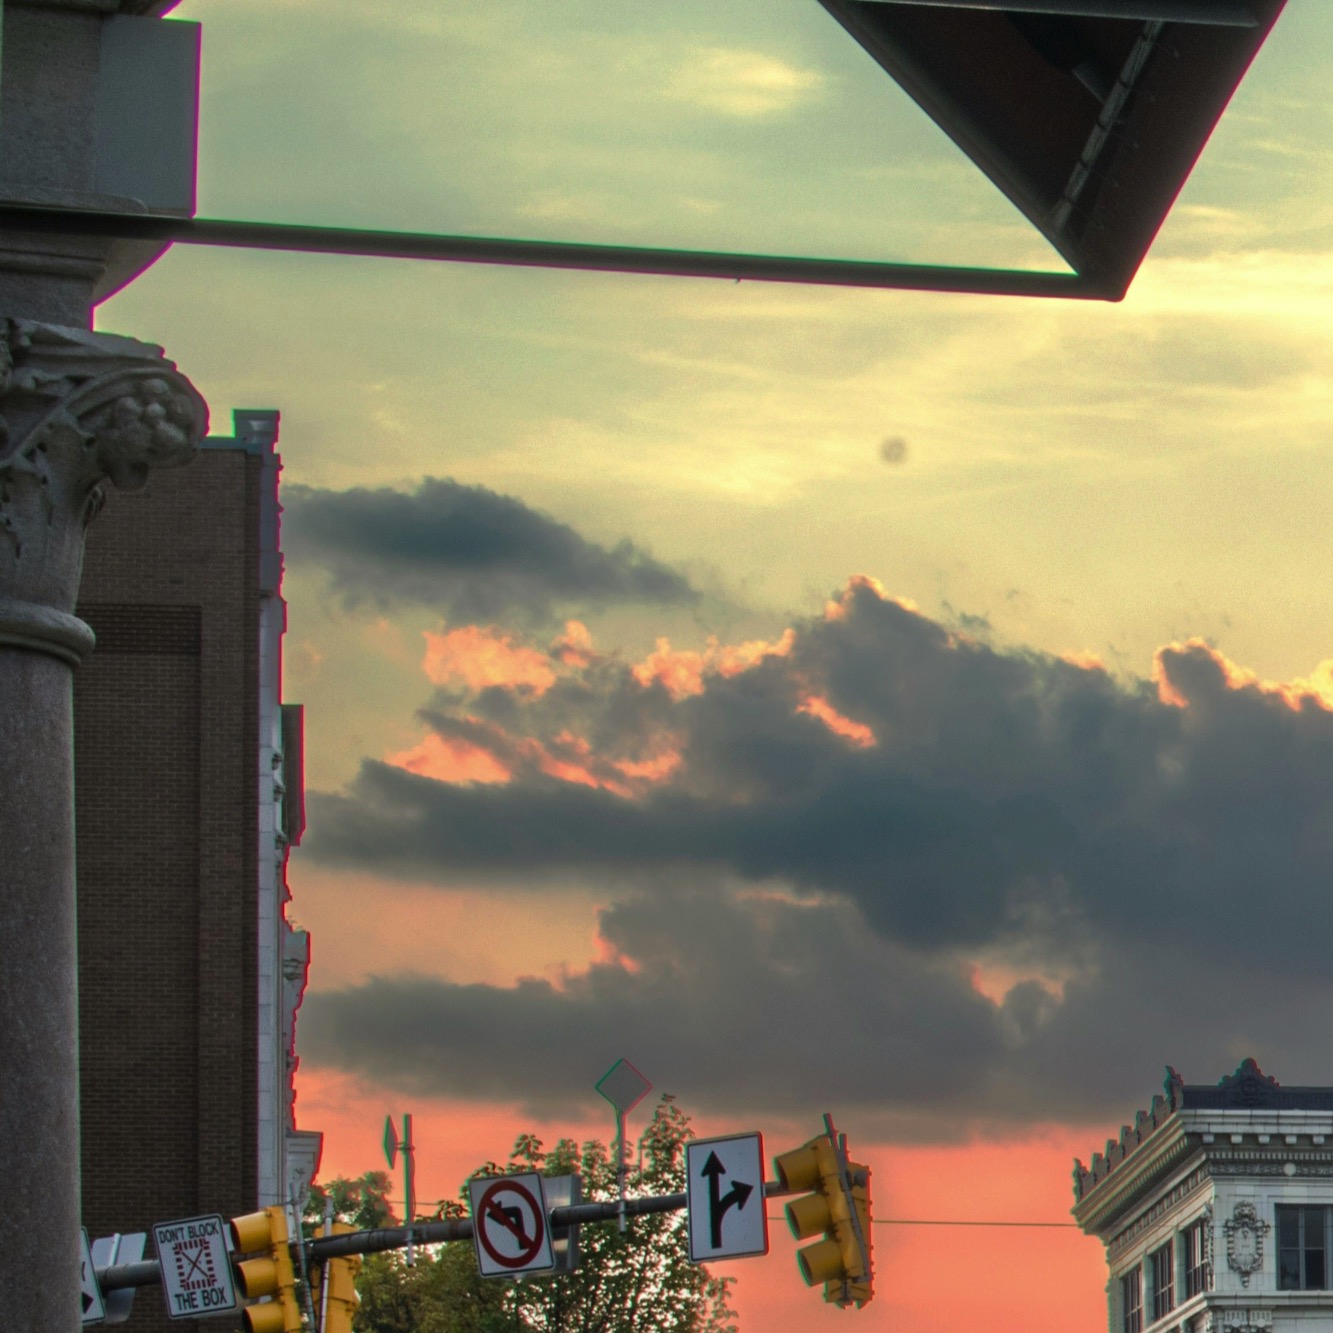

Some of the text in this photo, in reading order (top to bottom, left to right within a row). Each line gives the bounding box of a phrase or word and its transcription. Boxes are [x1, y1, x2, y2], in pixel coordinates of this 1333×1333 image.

[158, 1221, 219, 1244] DON'T BLOCK
[174, 1287, 228, 1311] THE BOX
